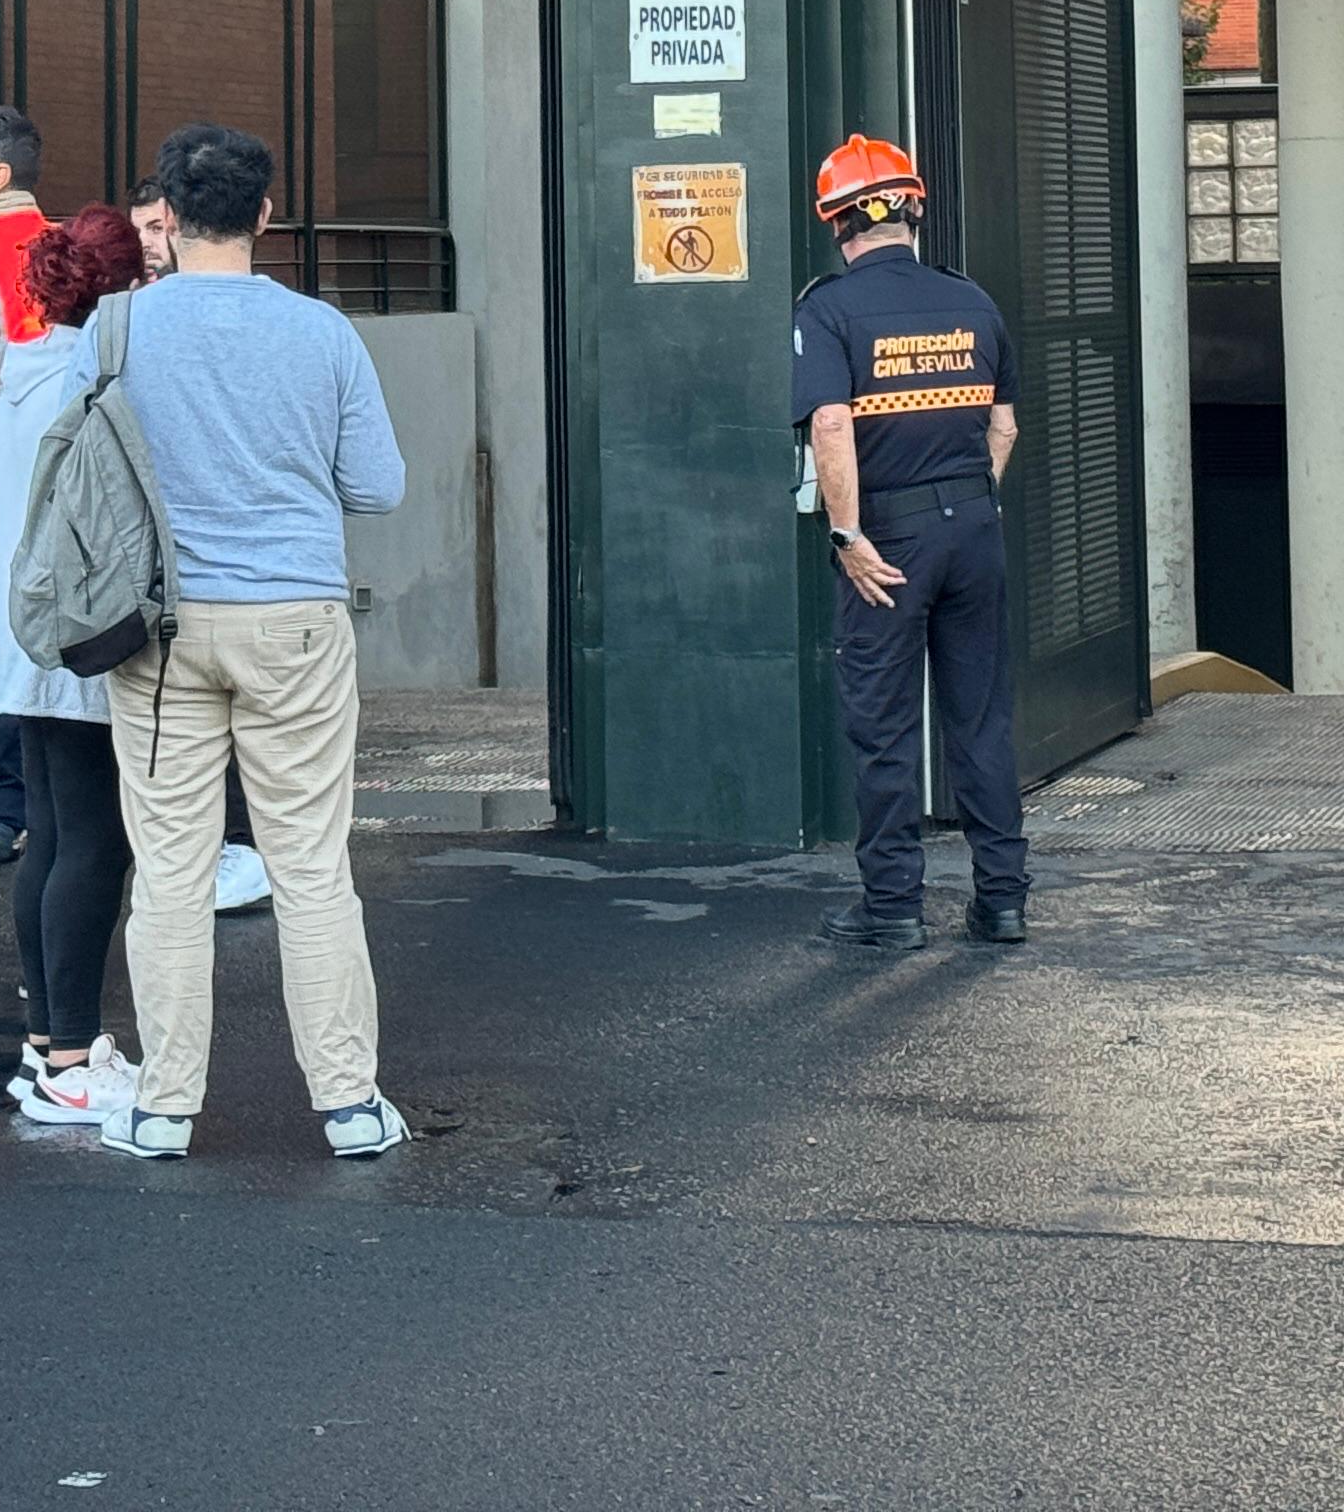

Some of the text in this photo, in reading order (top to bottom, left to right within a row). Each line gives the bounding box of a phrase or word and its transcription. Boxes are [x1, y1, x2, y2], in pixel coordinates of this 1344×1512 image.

[639, 5, 736, 33] PROPIEDAD
[651, 39, 725, 66] PRIVADA
[663, 169, 723, 182] SEGURIDAD
[701, 187, 742, 199] ACCESO
[649, 208, 656, 218] A
[657, 207, 688, 218] TODO
[873, 327, 975, 357] PROTECCIÓN
[873, 352, 975, 379] CIVIL SEVILLA
